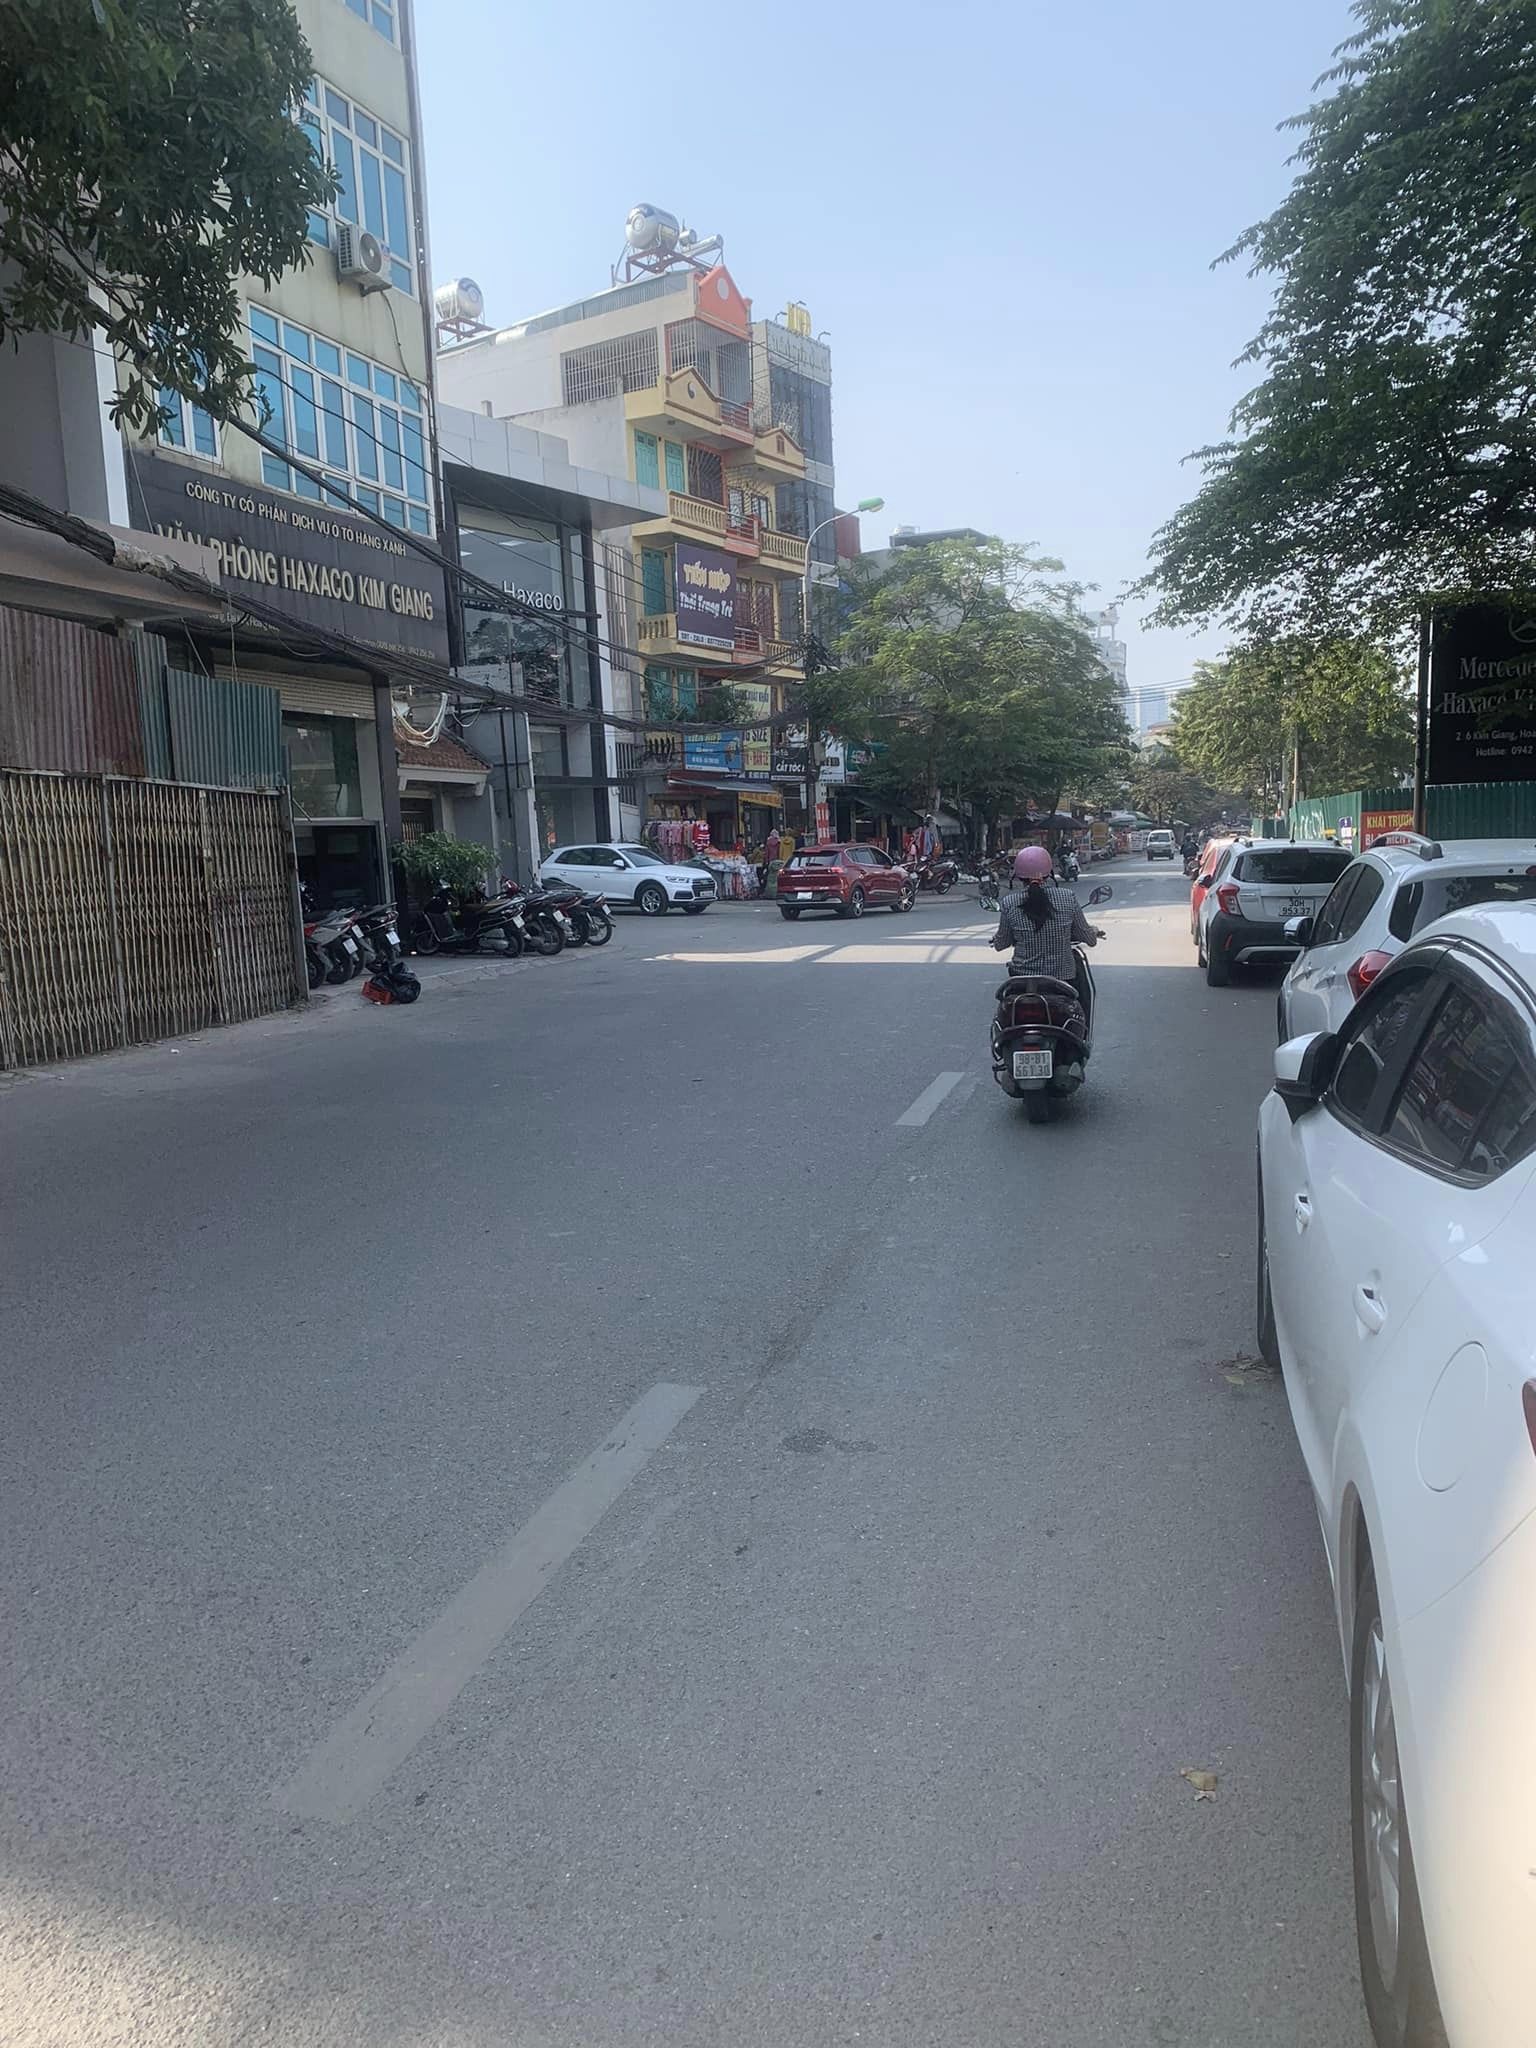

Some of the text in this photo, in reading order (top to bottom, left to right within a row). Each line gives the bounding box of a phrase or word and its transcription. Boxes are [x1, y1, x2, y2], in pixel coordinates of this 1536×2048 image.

[186, 481, 219, 504] CÔNG
[222, 492, 236, 509] TY
[383, 539, 406, 556] XANH
[282, 556, 354, 601] HAXACO
[359, 574, 386, 610] KIM
[391, 583, 433, 620] GIANG
[503, 580, 562, 611] Haxaco
[1366, 815, 1386, 829] KHAI
